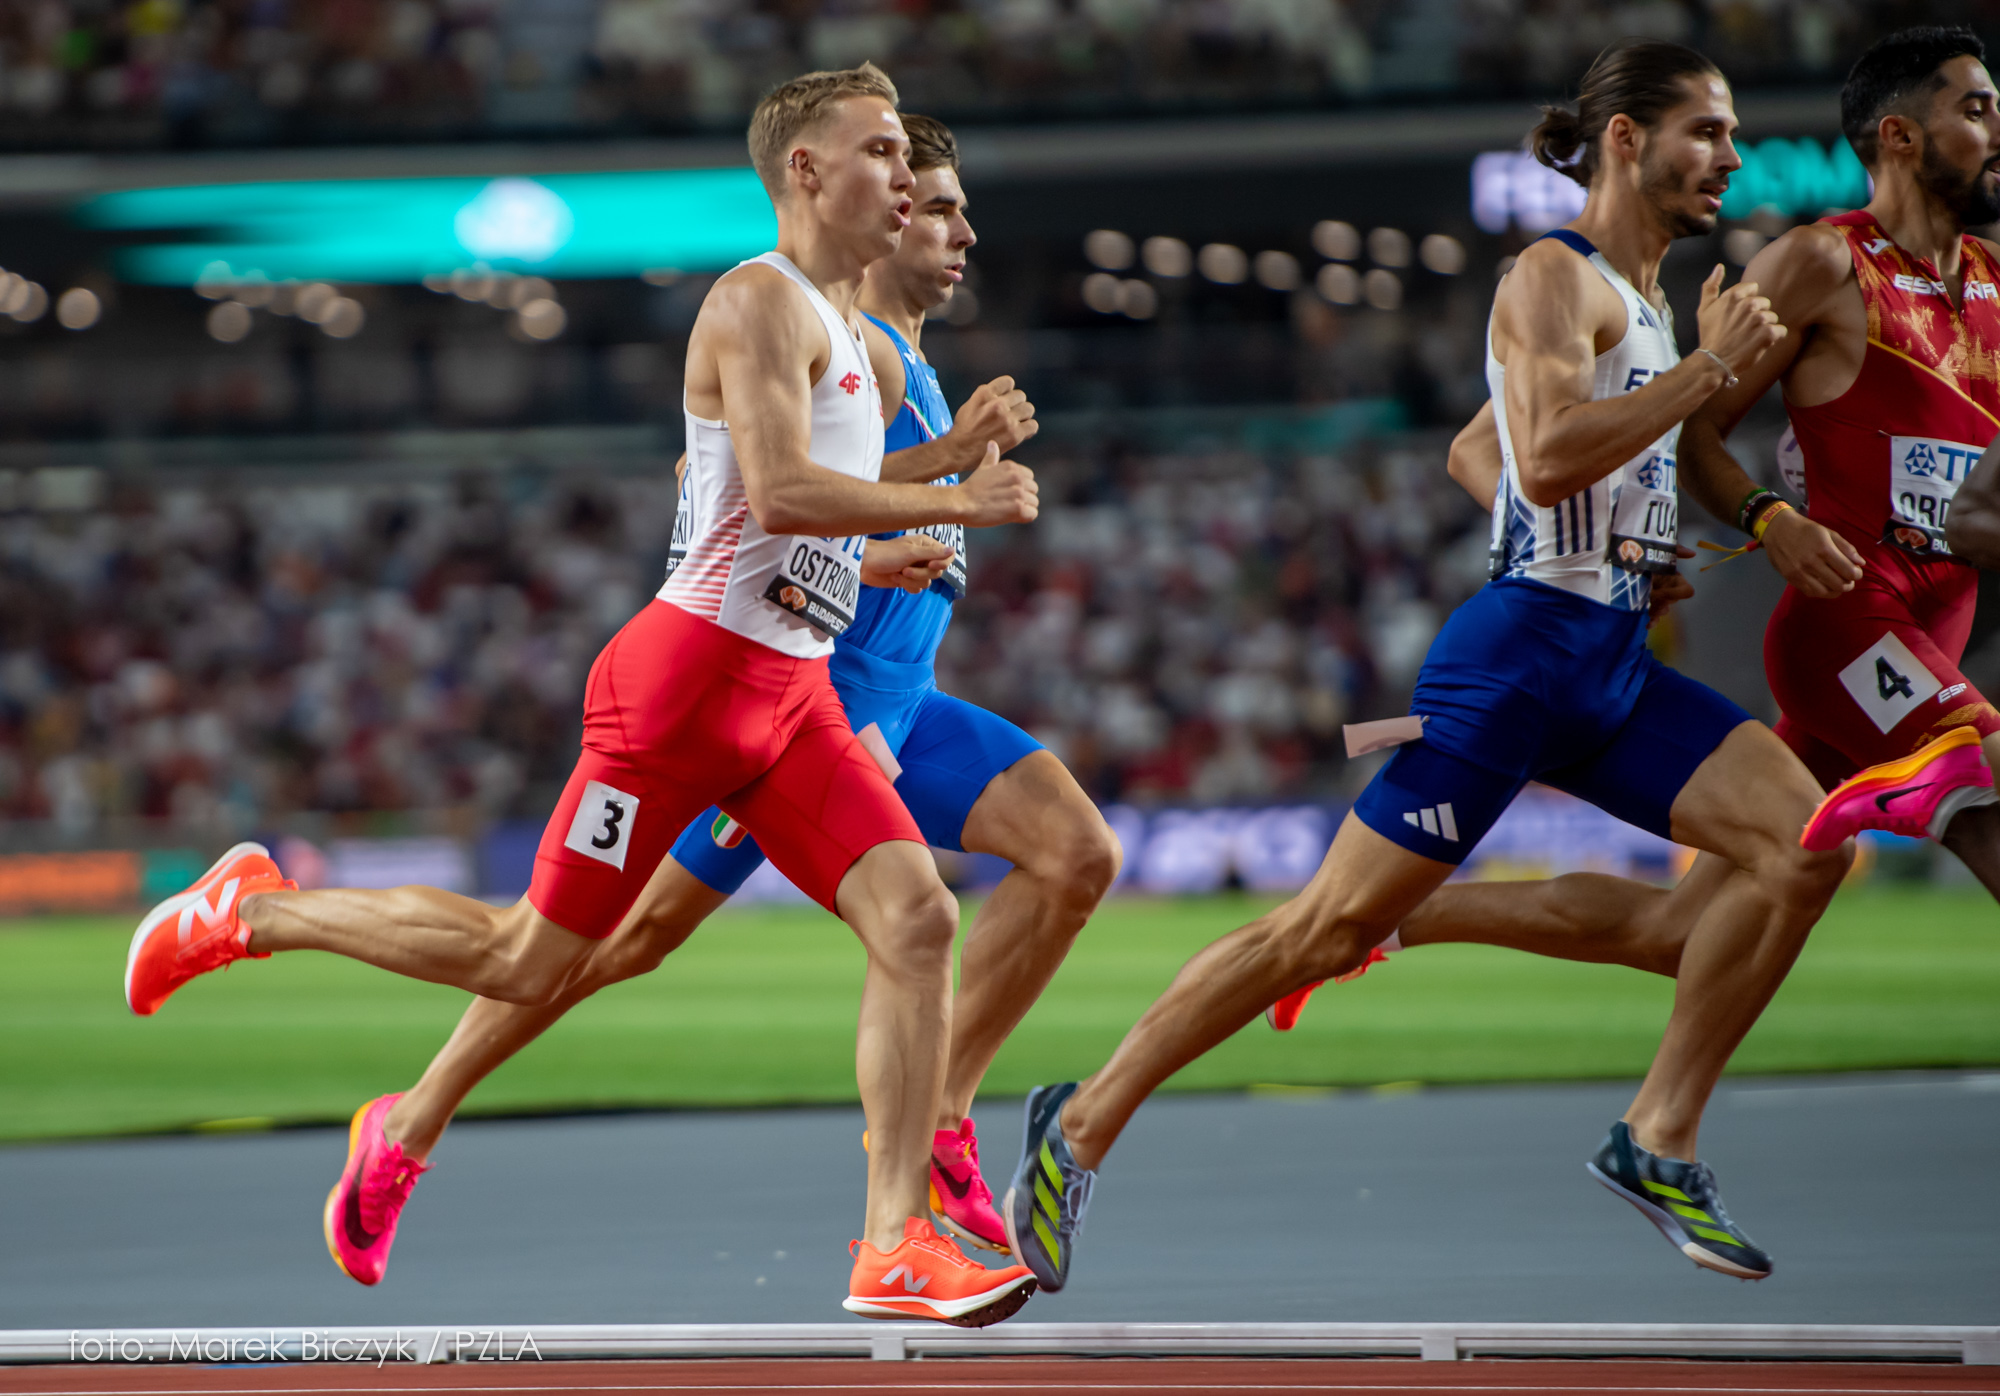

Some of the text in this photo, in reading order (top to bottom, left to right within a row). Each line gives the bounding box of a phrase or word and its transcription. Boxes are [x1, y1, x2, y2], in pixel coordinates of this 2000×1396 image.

[838, 371, 861, 395] 4F
[1876, 656, 1915, 701] 4
[591, 800, 624, 850] 3
